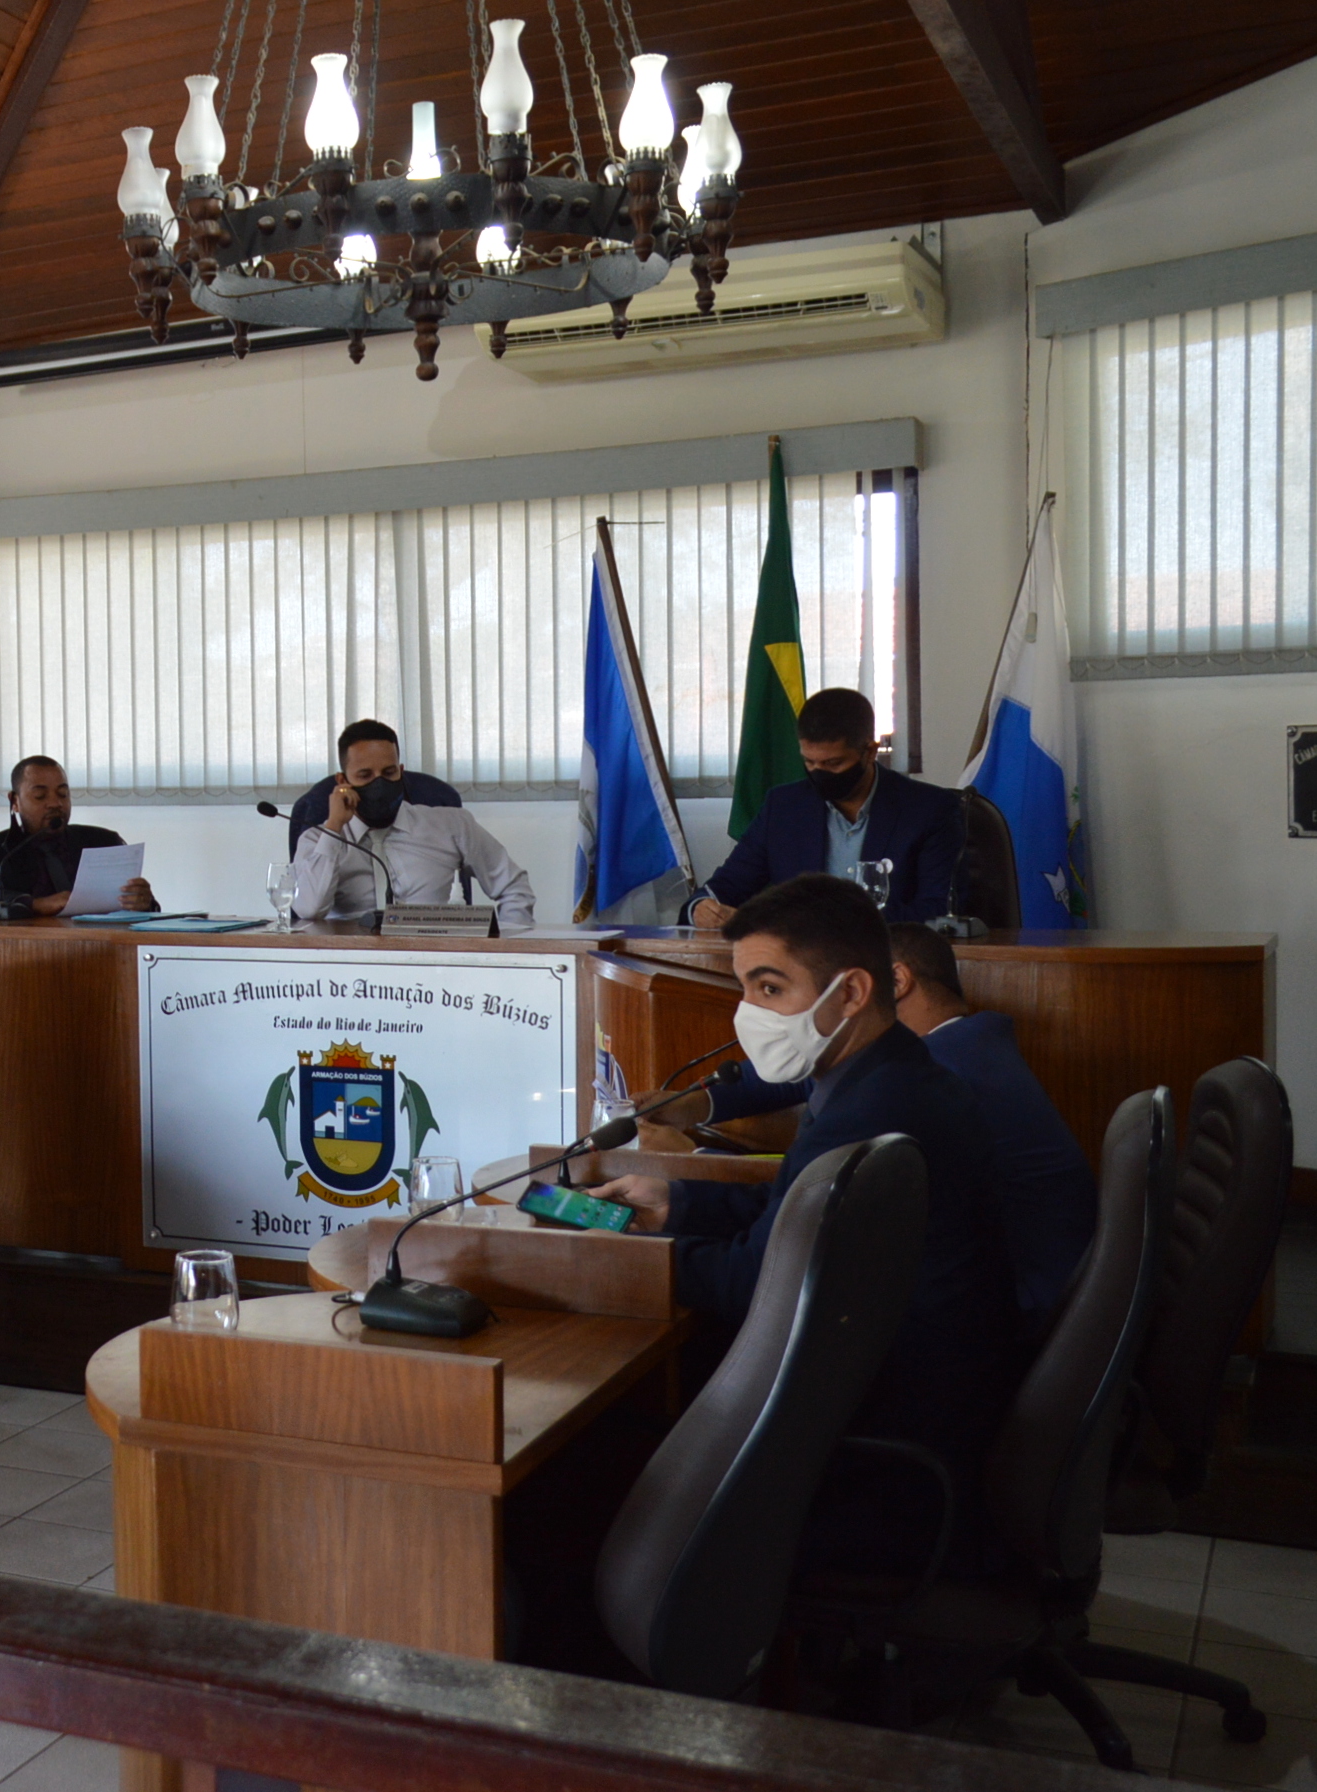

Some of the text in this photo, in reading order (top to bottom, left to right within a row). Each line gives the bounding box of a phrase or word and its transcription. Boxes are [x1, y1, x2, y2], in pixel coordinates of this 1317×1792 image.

[160, 978, 552, 1031] Câmara Municipal de Armação dos Búzios
[273, 1015, 423, 1034] Estado do Rio de Janeiro
[311, 1070, 383, 1081] ARMAÇÃO DOS BÚZIOS
[324, 1191, 376, 1205] 1740 1995
[251, 1209, 312, 1236] Poder
